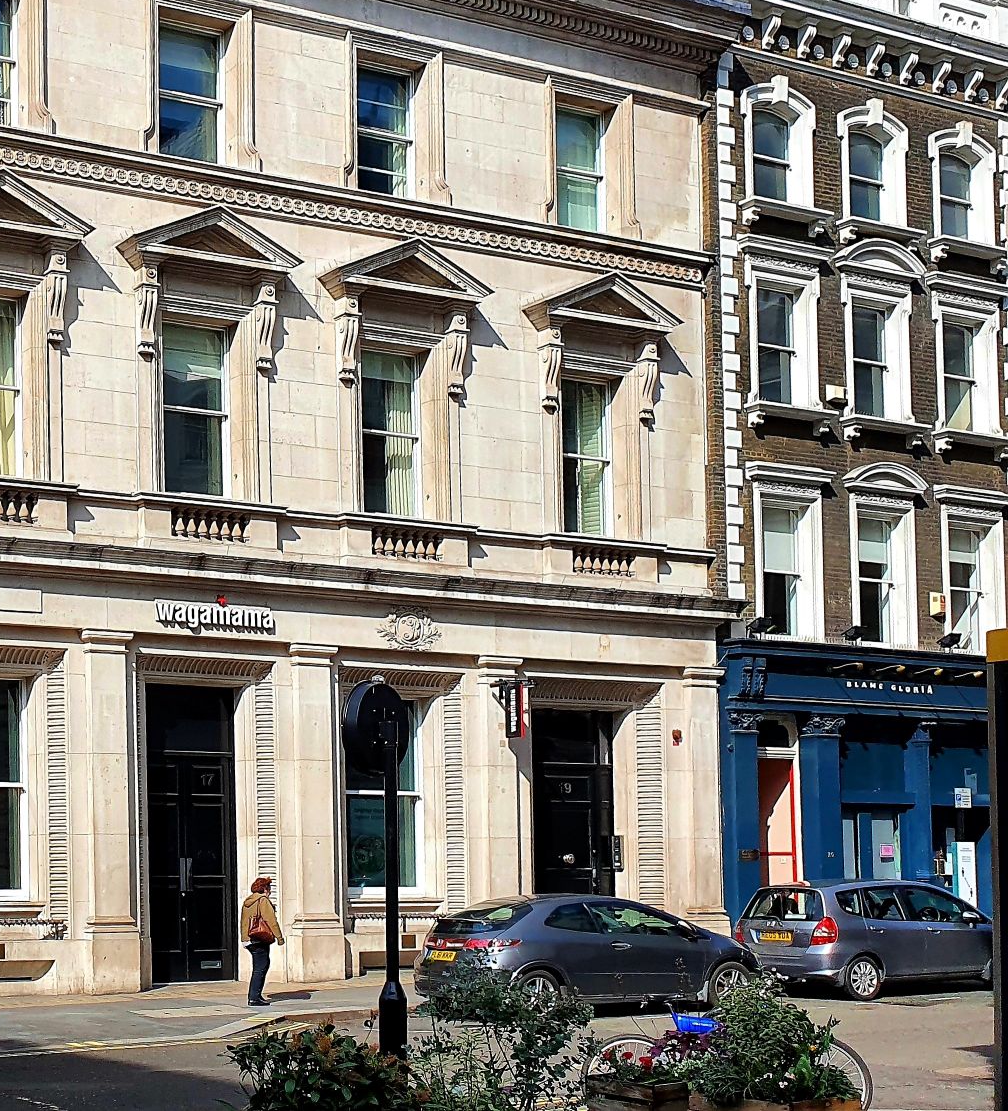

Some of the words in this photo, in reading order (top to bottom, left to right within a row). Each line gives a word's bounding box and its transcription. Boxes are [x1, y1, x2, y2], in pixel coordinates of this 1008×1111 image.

[155, 600, 274, 629] wagamama
[846, 681, 884, 690] BLAME
[890, 684, 933, 695] GLORIA
